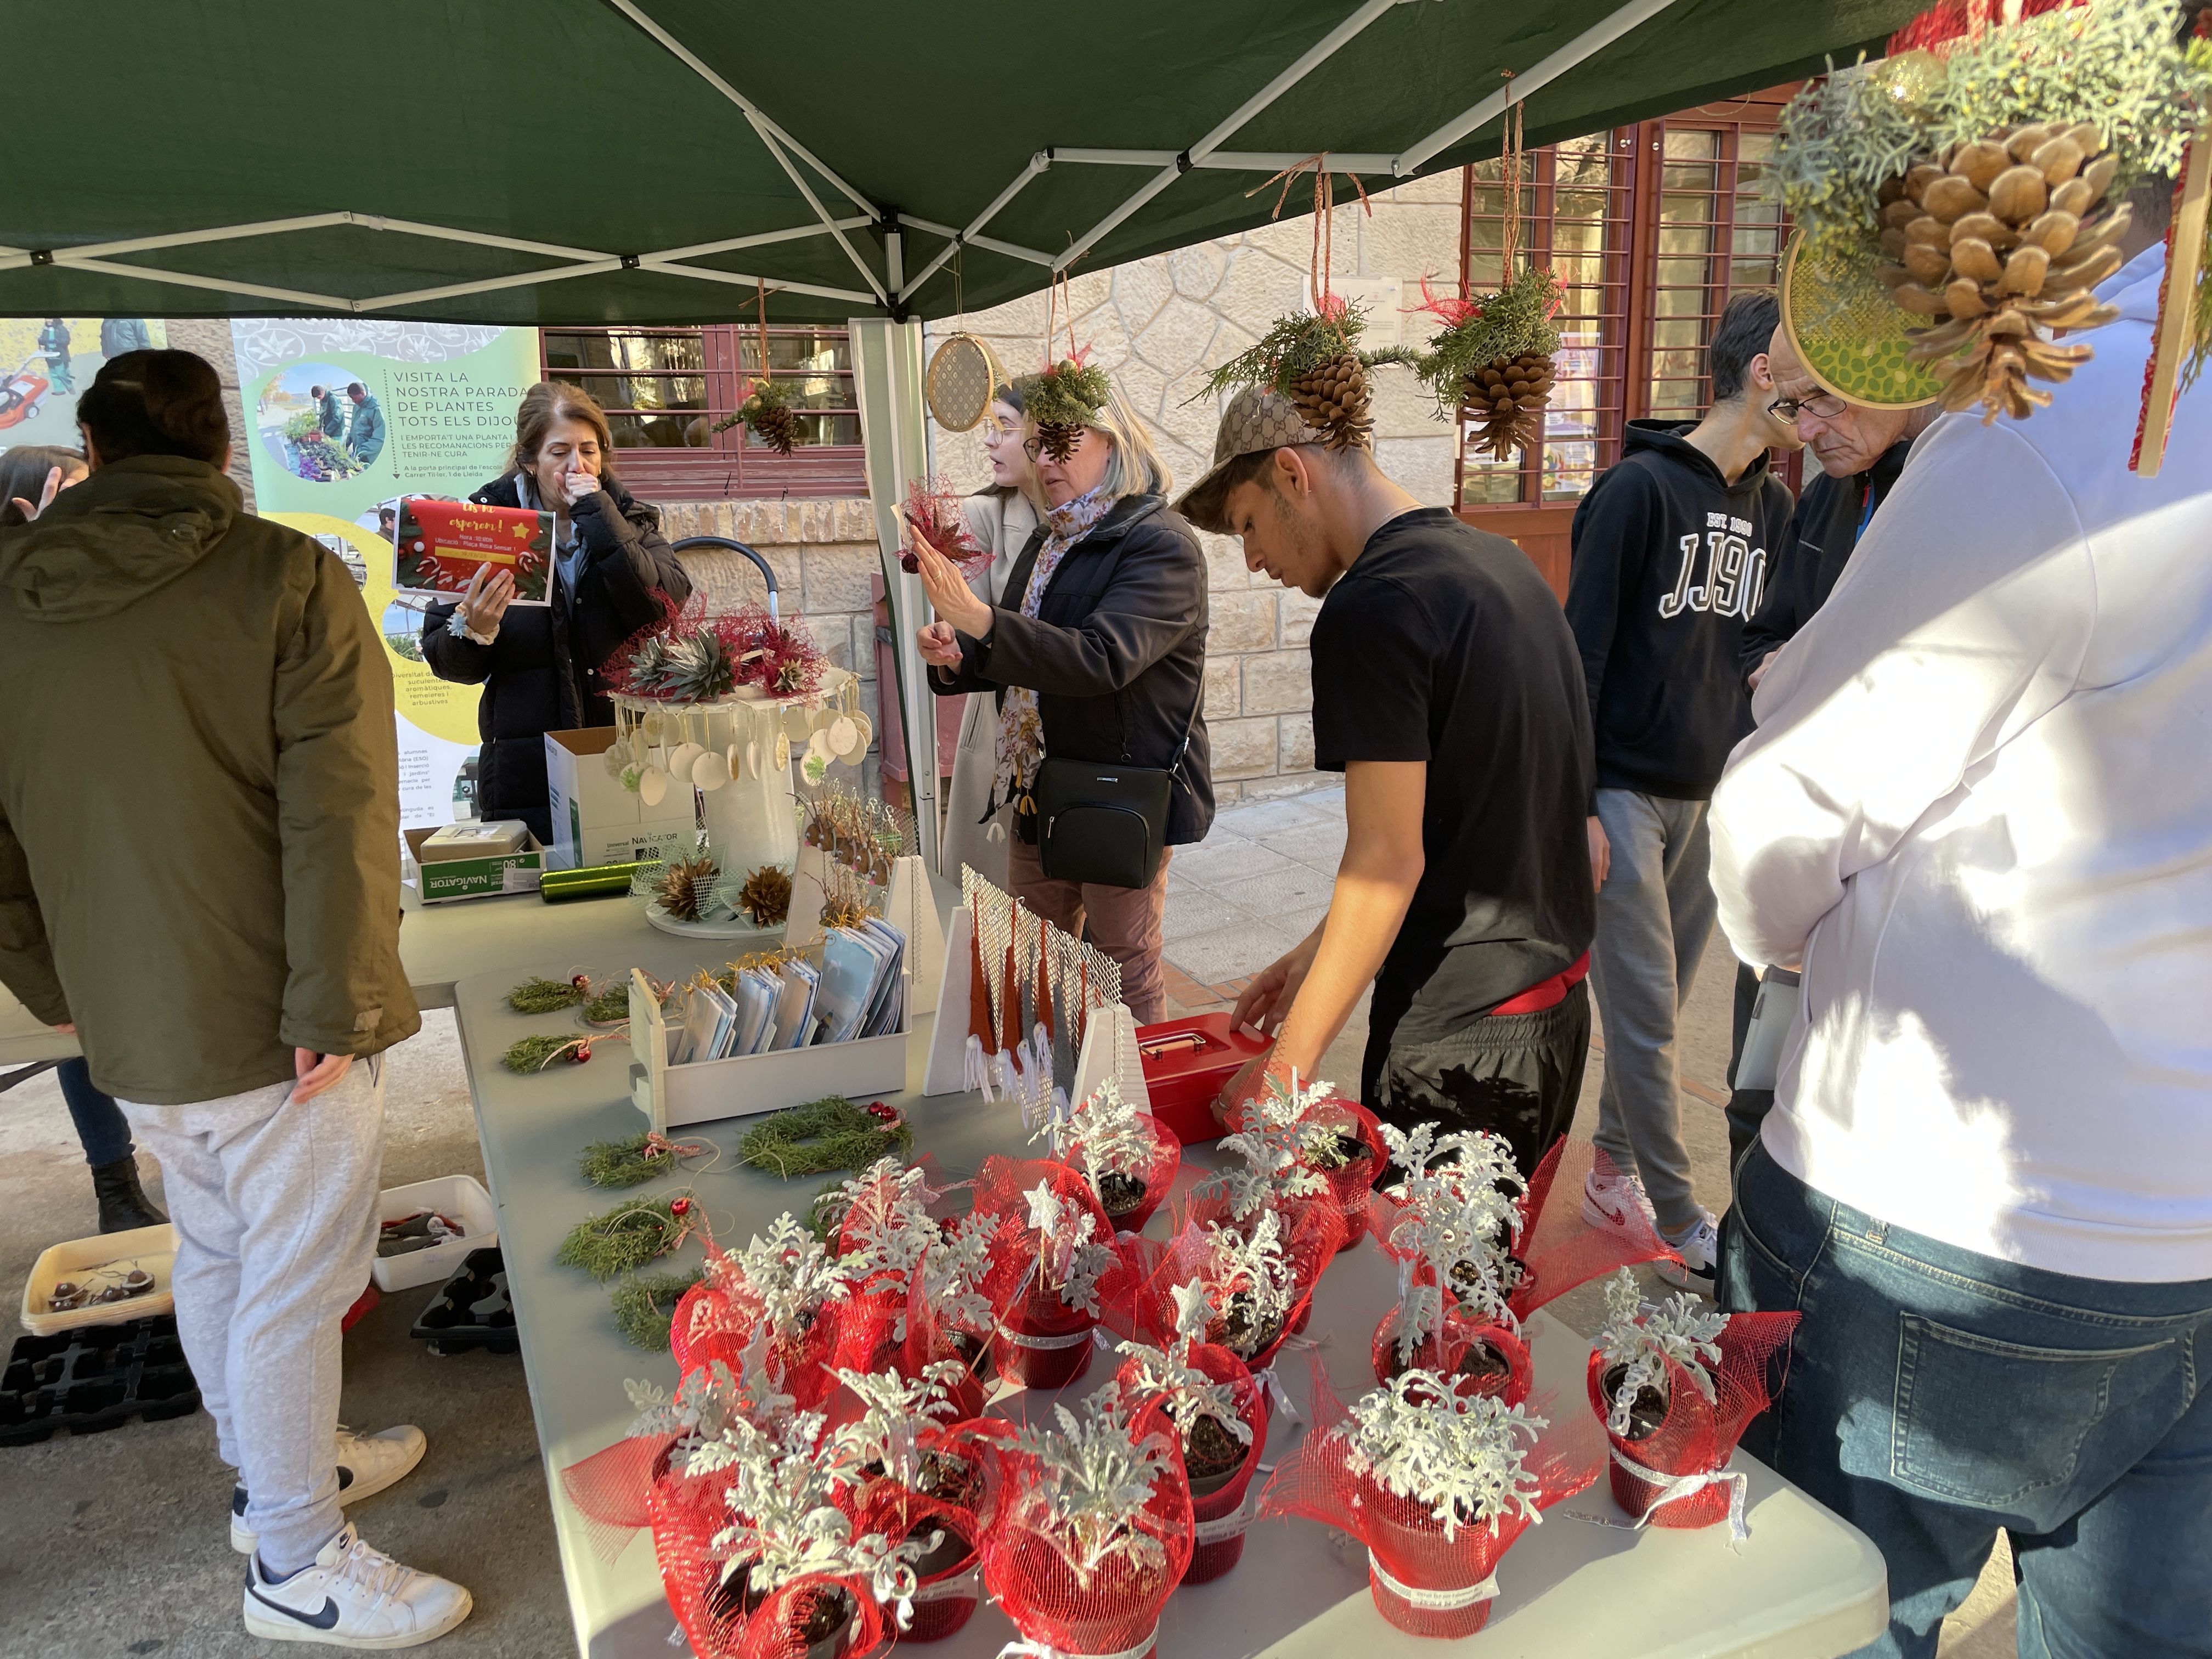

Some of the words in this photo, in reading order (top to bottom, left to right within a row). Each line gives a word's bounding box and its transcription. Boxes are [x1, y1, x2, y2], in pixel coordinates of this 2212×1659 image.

[393, 372, 444, 382] VISITA
[450, 372, 469, 382] LA
[396, 387, 460, 397] NOSTRA
[465, 387, 528, 397] PARADA
[398, 402, 419, 412] DE
[425, 402, 494, 412] PLANTES
[398, 416, 438, 426] TOTS
[444, 416, 471, 426] ELS
[1729, 516, 1753, 537] 1990
[430, 874, 487, 890] NAVIGATOR
